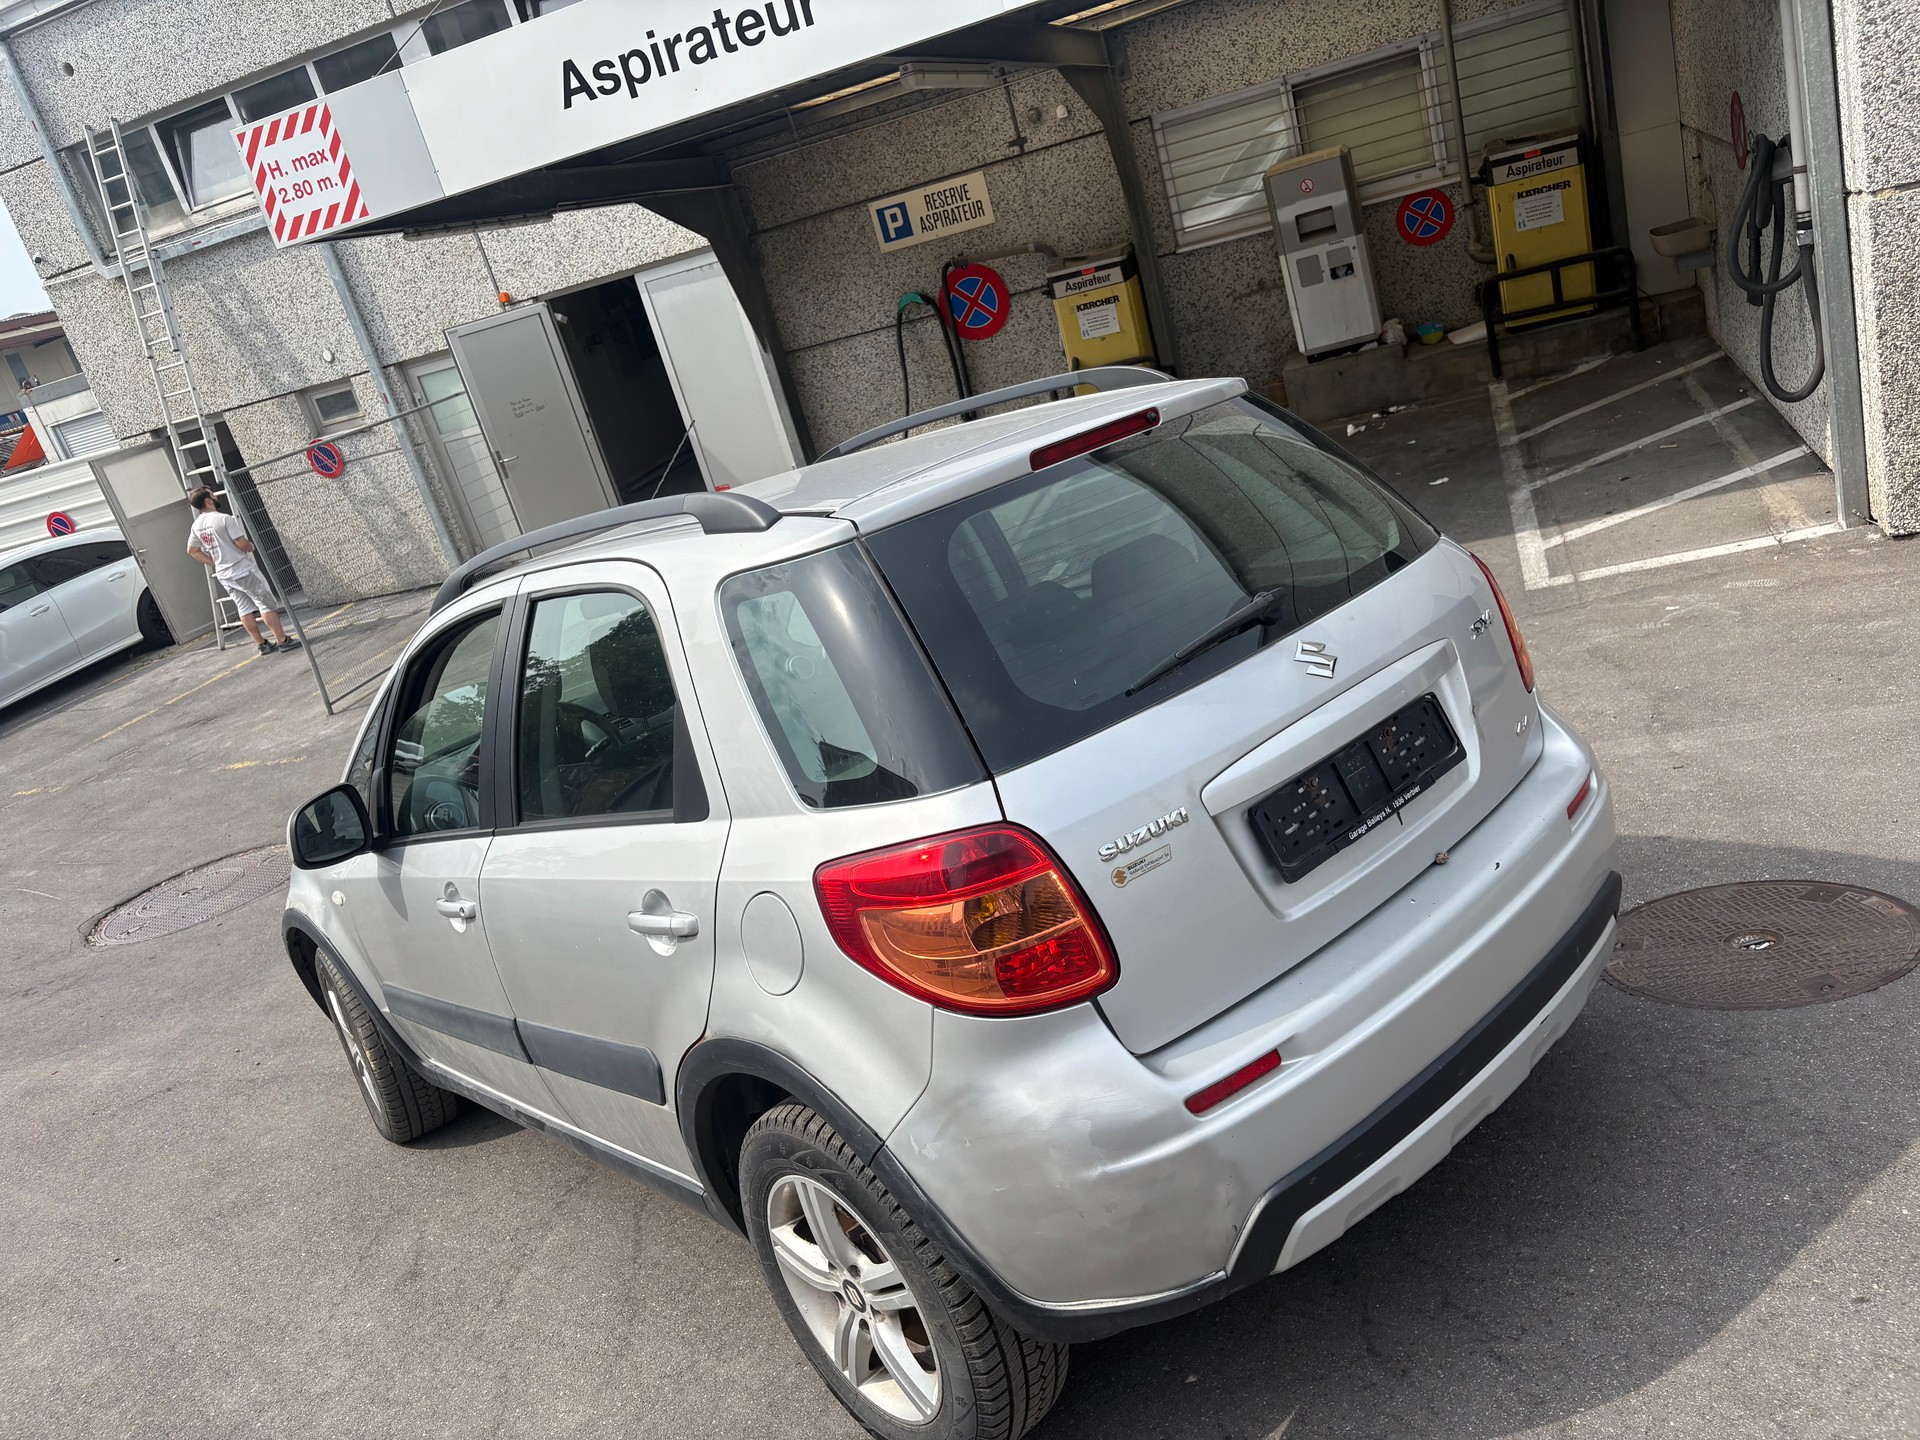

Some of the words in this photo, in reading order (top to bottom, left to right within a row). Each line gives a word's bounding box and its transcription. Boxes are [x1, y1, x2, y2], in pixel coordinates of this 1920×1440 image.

[563, 0, 815, 110] Aspirateur
[267, 159, 289, 180] H.
[291, 148, 329, 173] max
[1506, 155, 1565, 177] Aspirateur
[278, 179, 314, 204] 2.80
[316, 175, 338, 192] m.
[923, 183, 971, 212] RESERVE
[883, 206, 904, 239] P
[919, 199, 986, 233] ASPIRATEUR
[1065, 273, 1112, 292] Aspirateur
[1098, 807, 1189, 863] SUZUKI
[1348, 823, 1368, 840] Garage
[1127, 859, 1146, 871] SUZUKI
